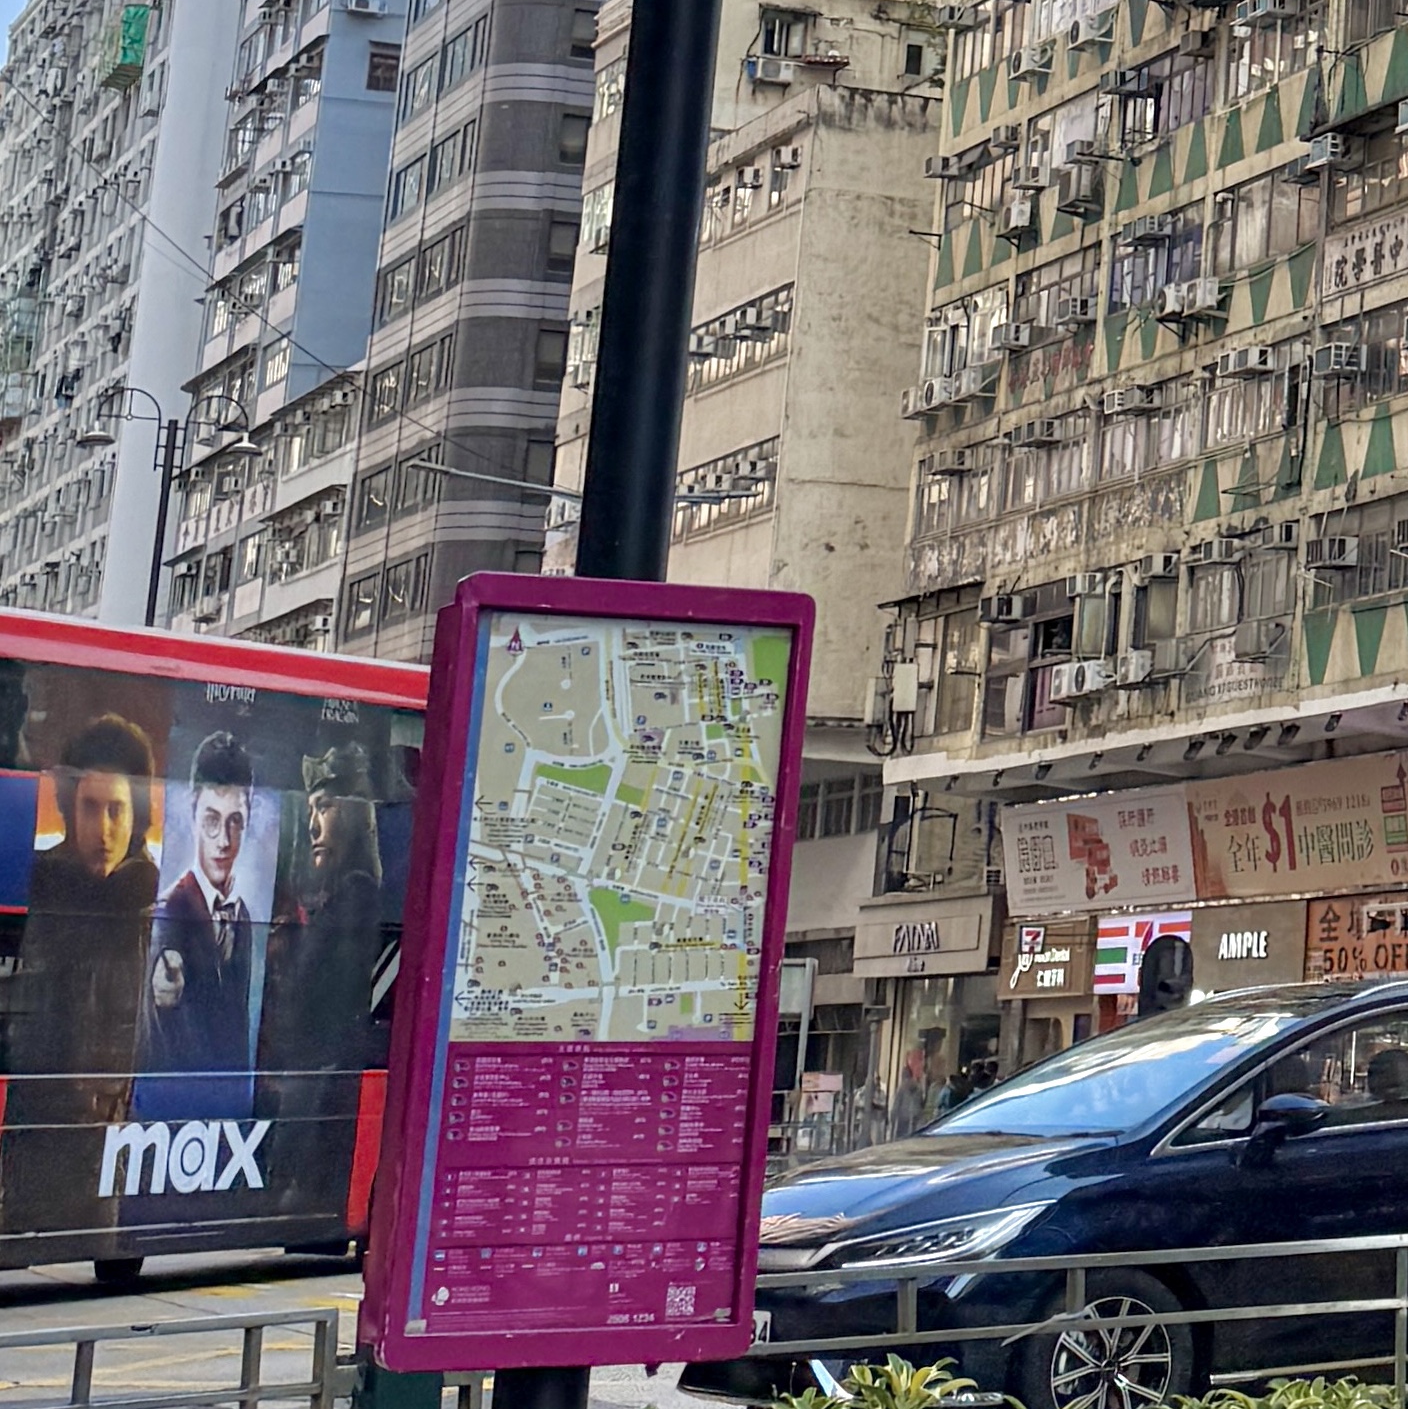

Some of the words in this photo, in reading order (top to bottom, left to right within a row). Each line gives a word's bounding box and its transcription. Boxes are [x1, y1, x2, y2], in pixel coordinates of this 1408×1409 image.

[1227, 832, 1262, 874] 全年
[1262, 792, 1297, 873] $1
[1297, 819, 1375, 866] 中醫問診
[1218, 930, 1269, 961] AMPLE
[1323, 947, 1368, 973] 50%
[98, 1119, 272, 1198] max
